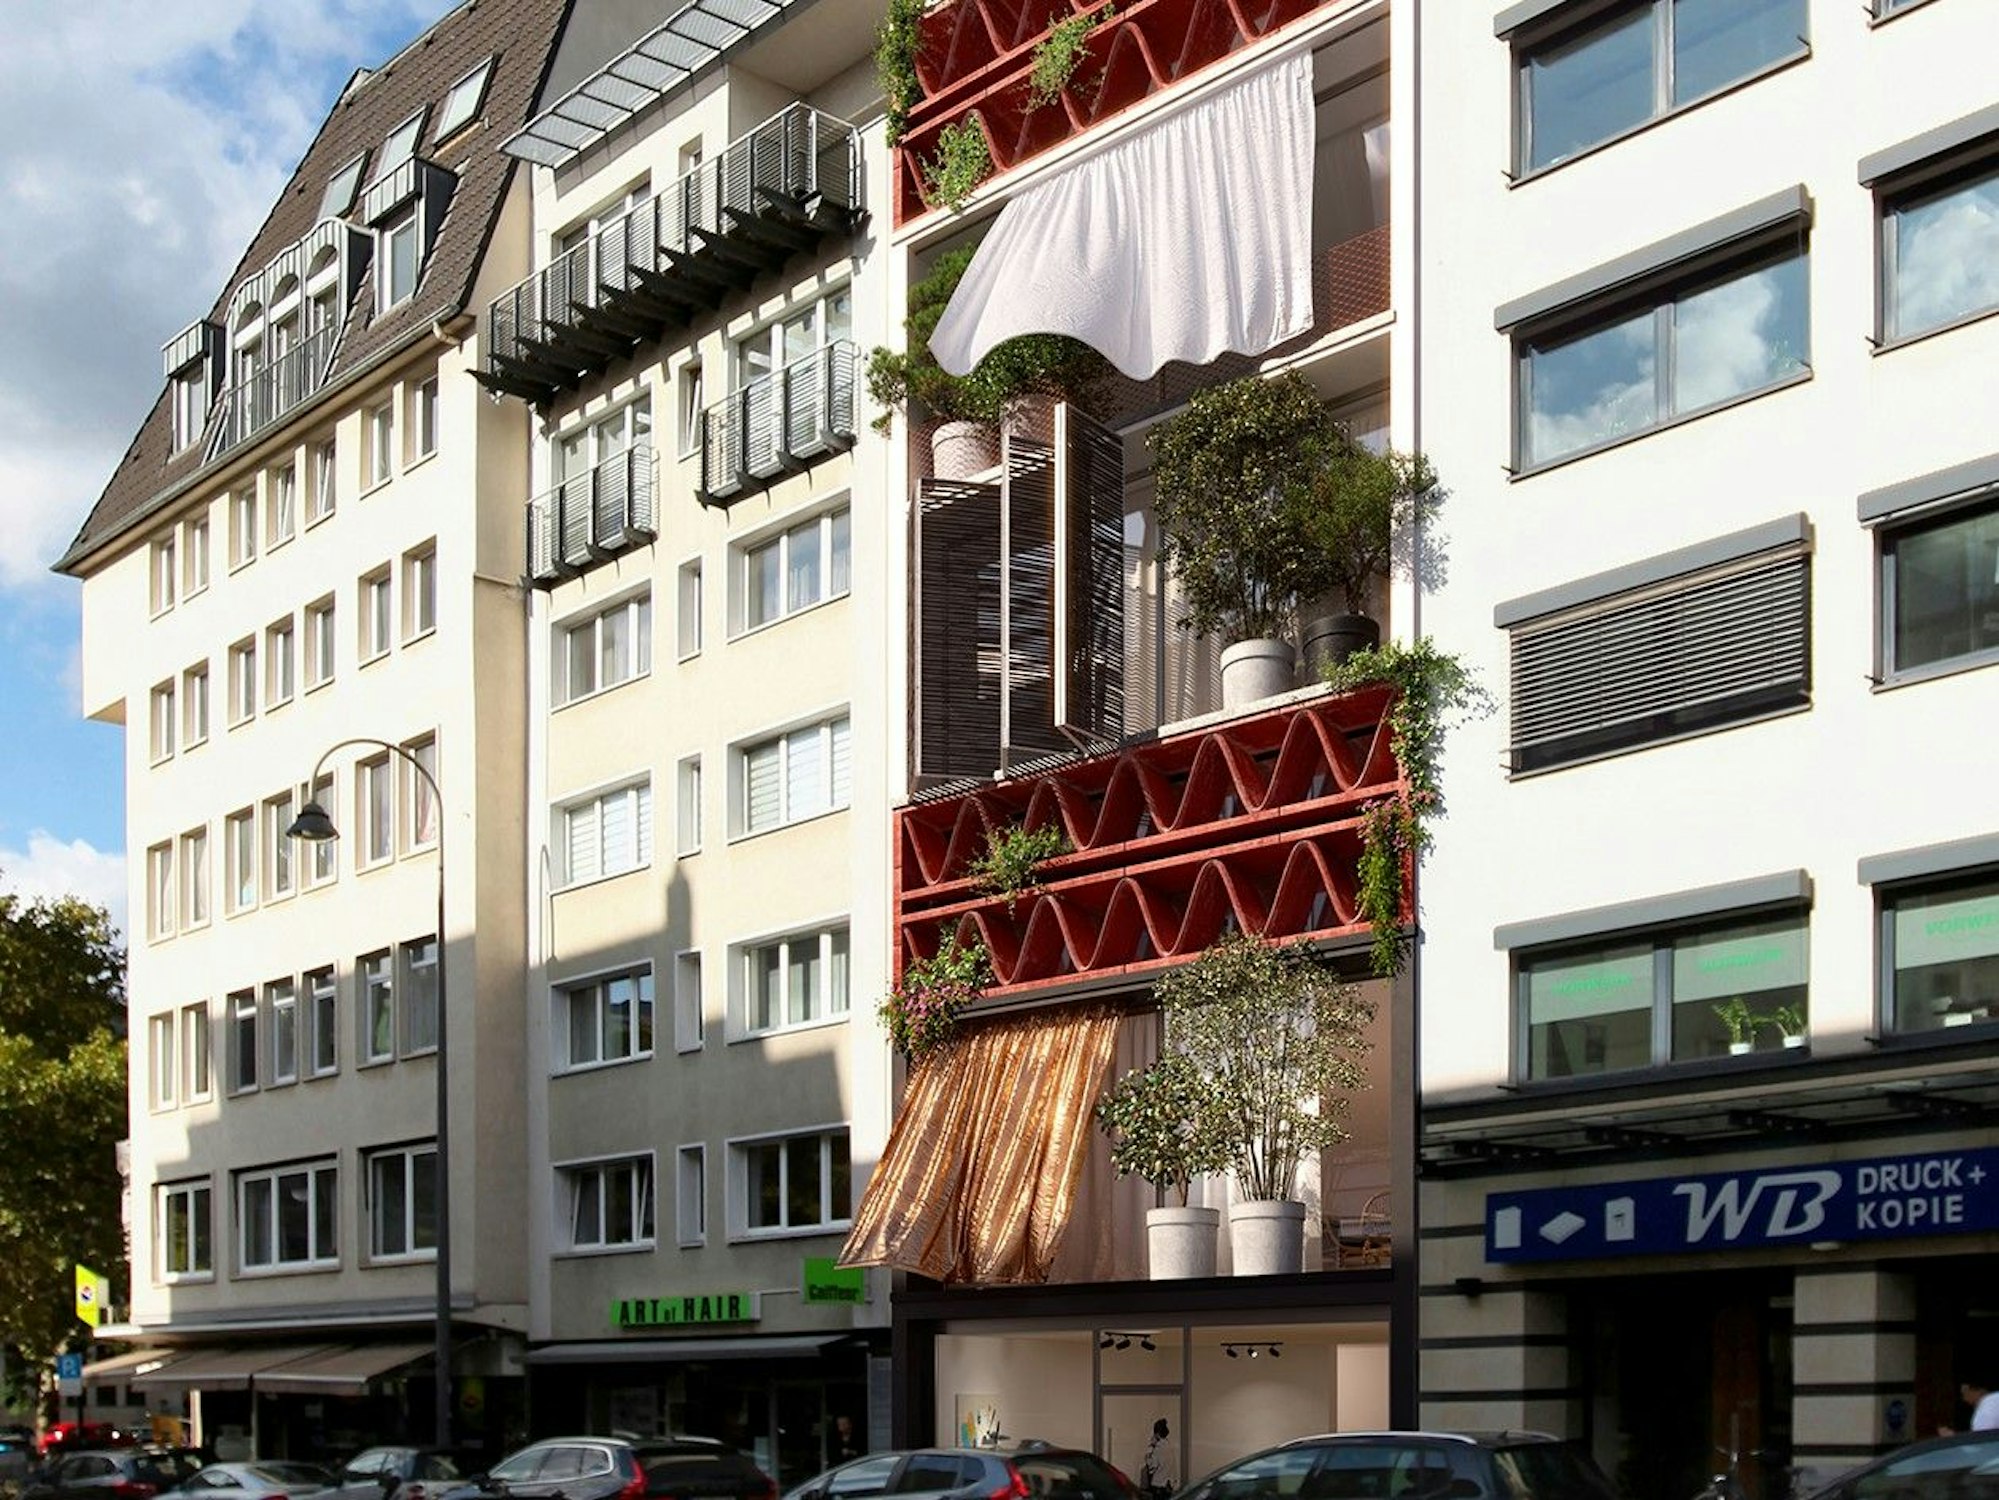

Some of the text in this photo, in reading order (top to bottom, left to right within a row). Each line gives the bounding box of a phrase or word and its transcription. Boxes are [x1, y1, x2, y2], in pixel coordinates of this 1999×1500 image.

[1672, 1169, 1843, 1243] WB
[1857, 1194, 1964, 1230] KOPIE
[619, 1300, 660, 1324] ART
[683, 1295, 741, 1321] HAIR
